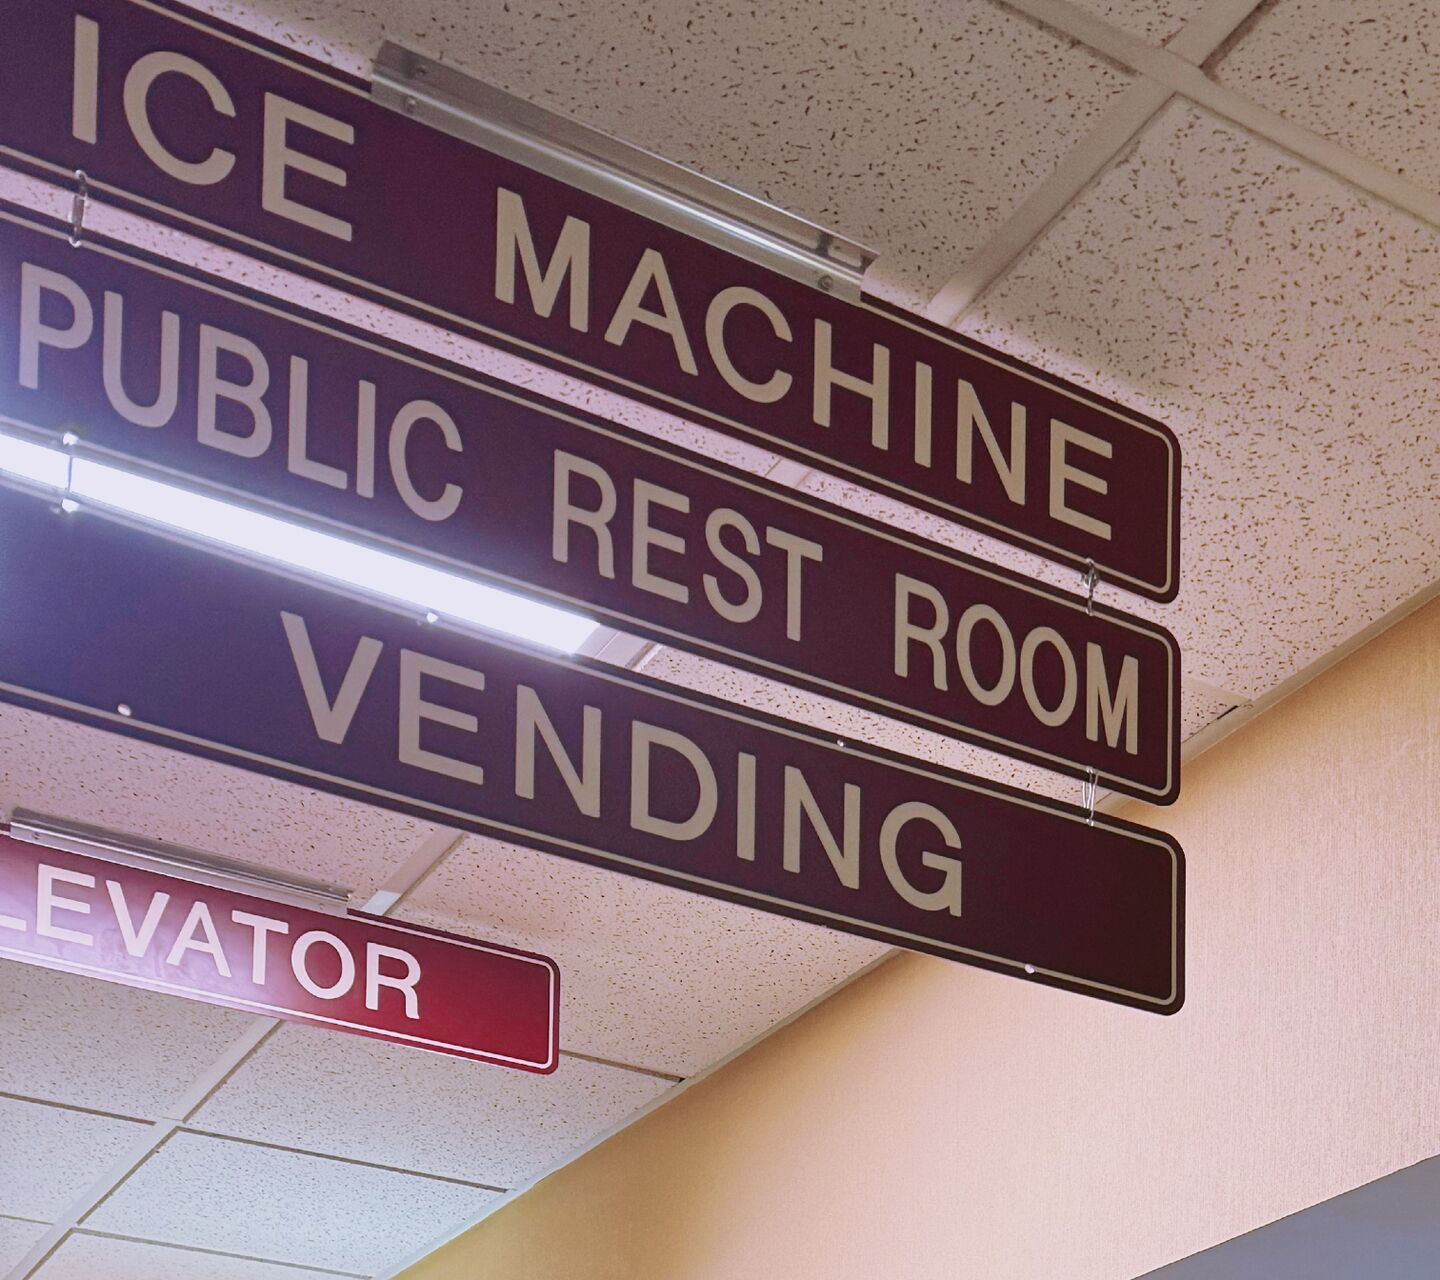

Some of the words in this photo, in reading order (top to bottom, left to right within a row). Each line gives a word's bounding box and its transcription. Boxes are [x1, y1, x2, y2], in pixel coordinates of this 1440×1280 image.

[18, 259, 464, 523] PUBLIC
[550, 447, 823, 643] REST
[892, 575, 1140, 757] ROOM
[72, 12, 355, 242] ICE
[495, 185, 1114, 541] MACHINE
[279, 609, 964, 919] VENDING
